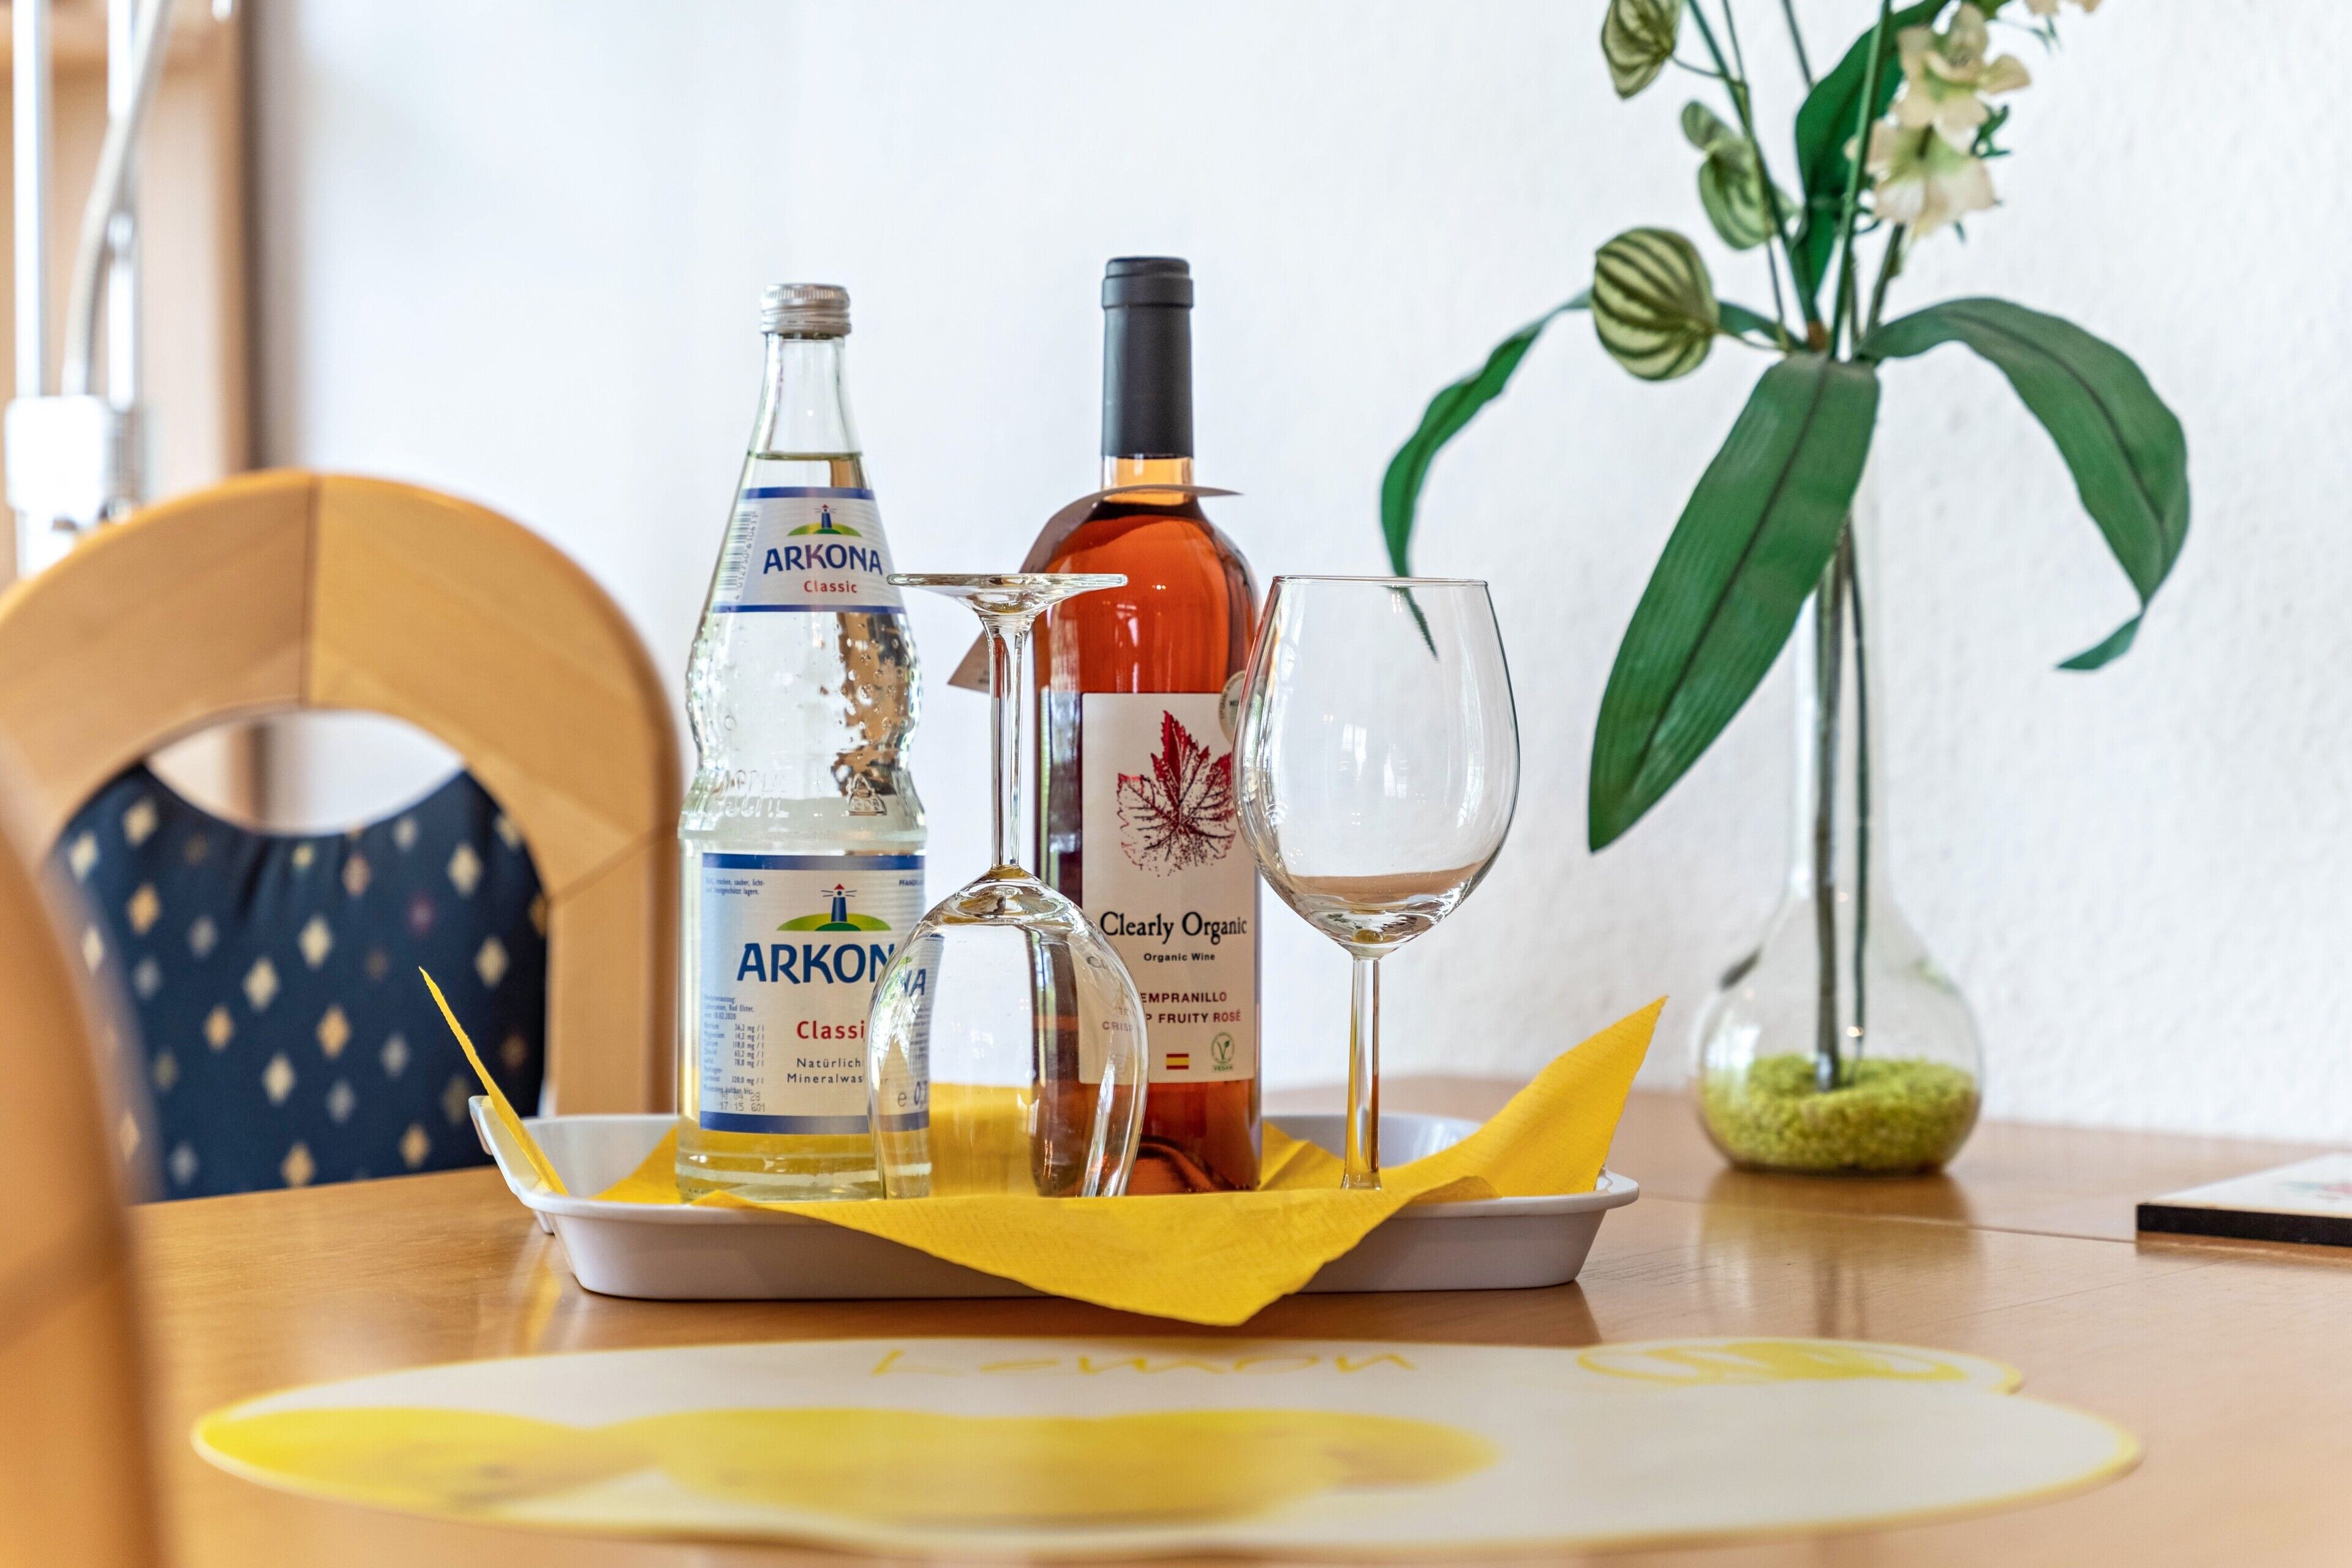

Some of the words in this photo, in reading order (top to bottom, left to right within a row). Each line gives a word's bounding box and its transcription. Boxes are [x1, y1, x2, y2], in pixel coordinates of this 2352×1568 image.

[763, 543, 883, 576] ARKONA
[804, 580, 858, 593] Classic
[1100, 911, 1174, 944] Clearly
[1182, 911, 1247, 945] Organic
[737, 943, 895, 984] ARKON
[1144, 953, 1187, 963] Organic
[1140, 992, 1227, 1003] EMPRANILLO
[1158, 1013, 1209, 1023] FRUITY
[1213, 1010, 1242, 1023] ROSÉ
[796, 1020, 864, 1039] Classi
[796, 1058, 861, 1068] Natürlich
[787, 1073, 863, 1084] Mineralwas
